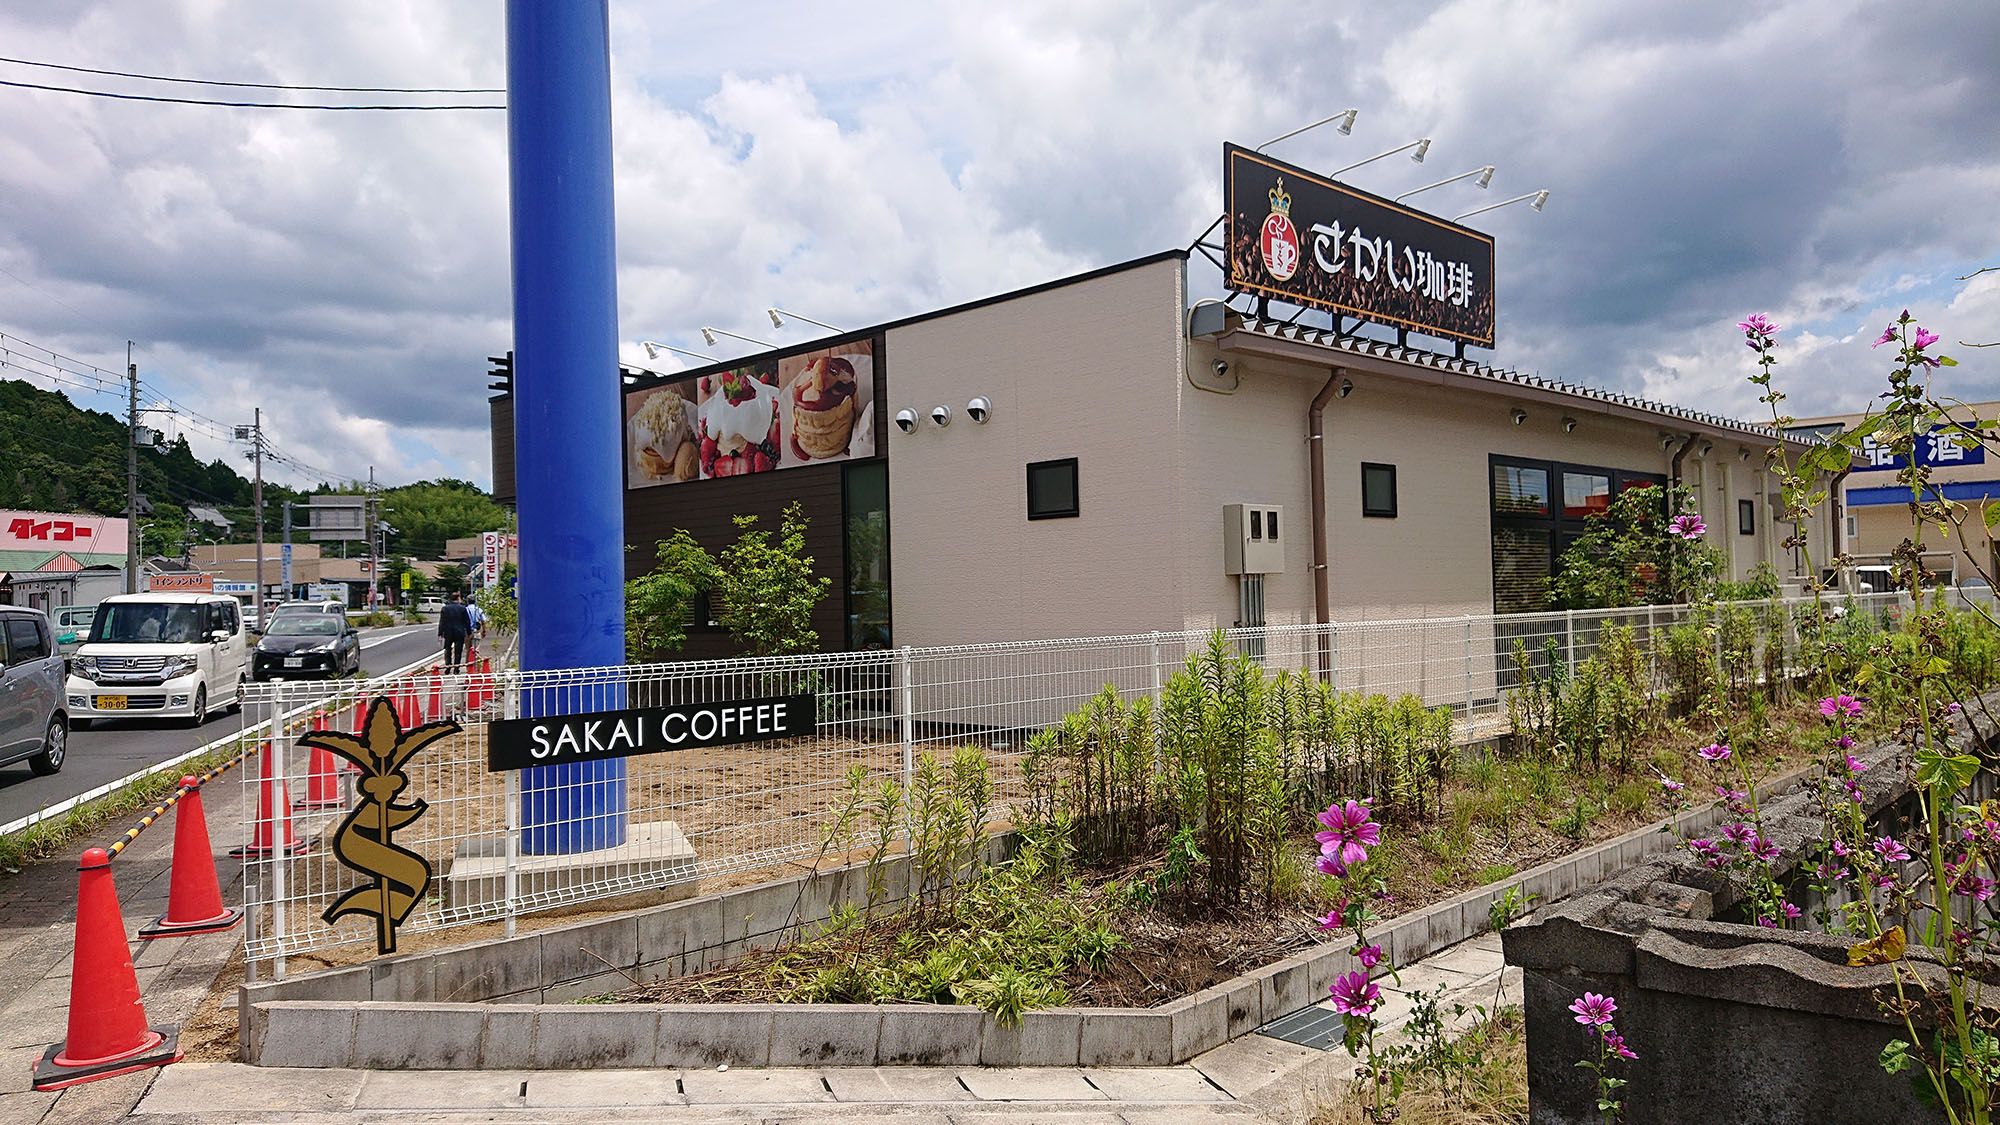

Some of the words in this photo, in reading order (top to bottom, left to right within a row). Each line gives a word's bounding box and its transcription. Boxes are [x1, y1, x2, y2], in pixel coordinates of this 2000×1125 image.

[1310, 219, 1473, 309] さかい珈琲
[7, 518, 92, 541] ダイコー
[530, 716, 643, 759] SAKAI
[661, 703, 787, 744] COFFEE
